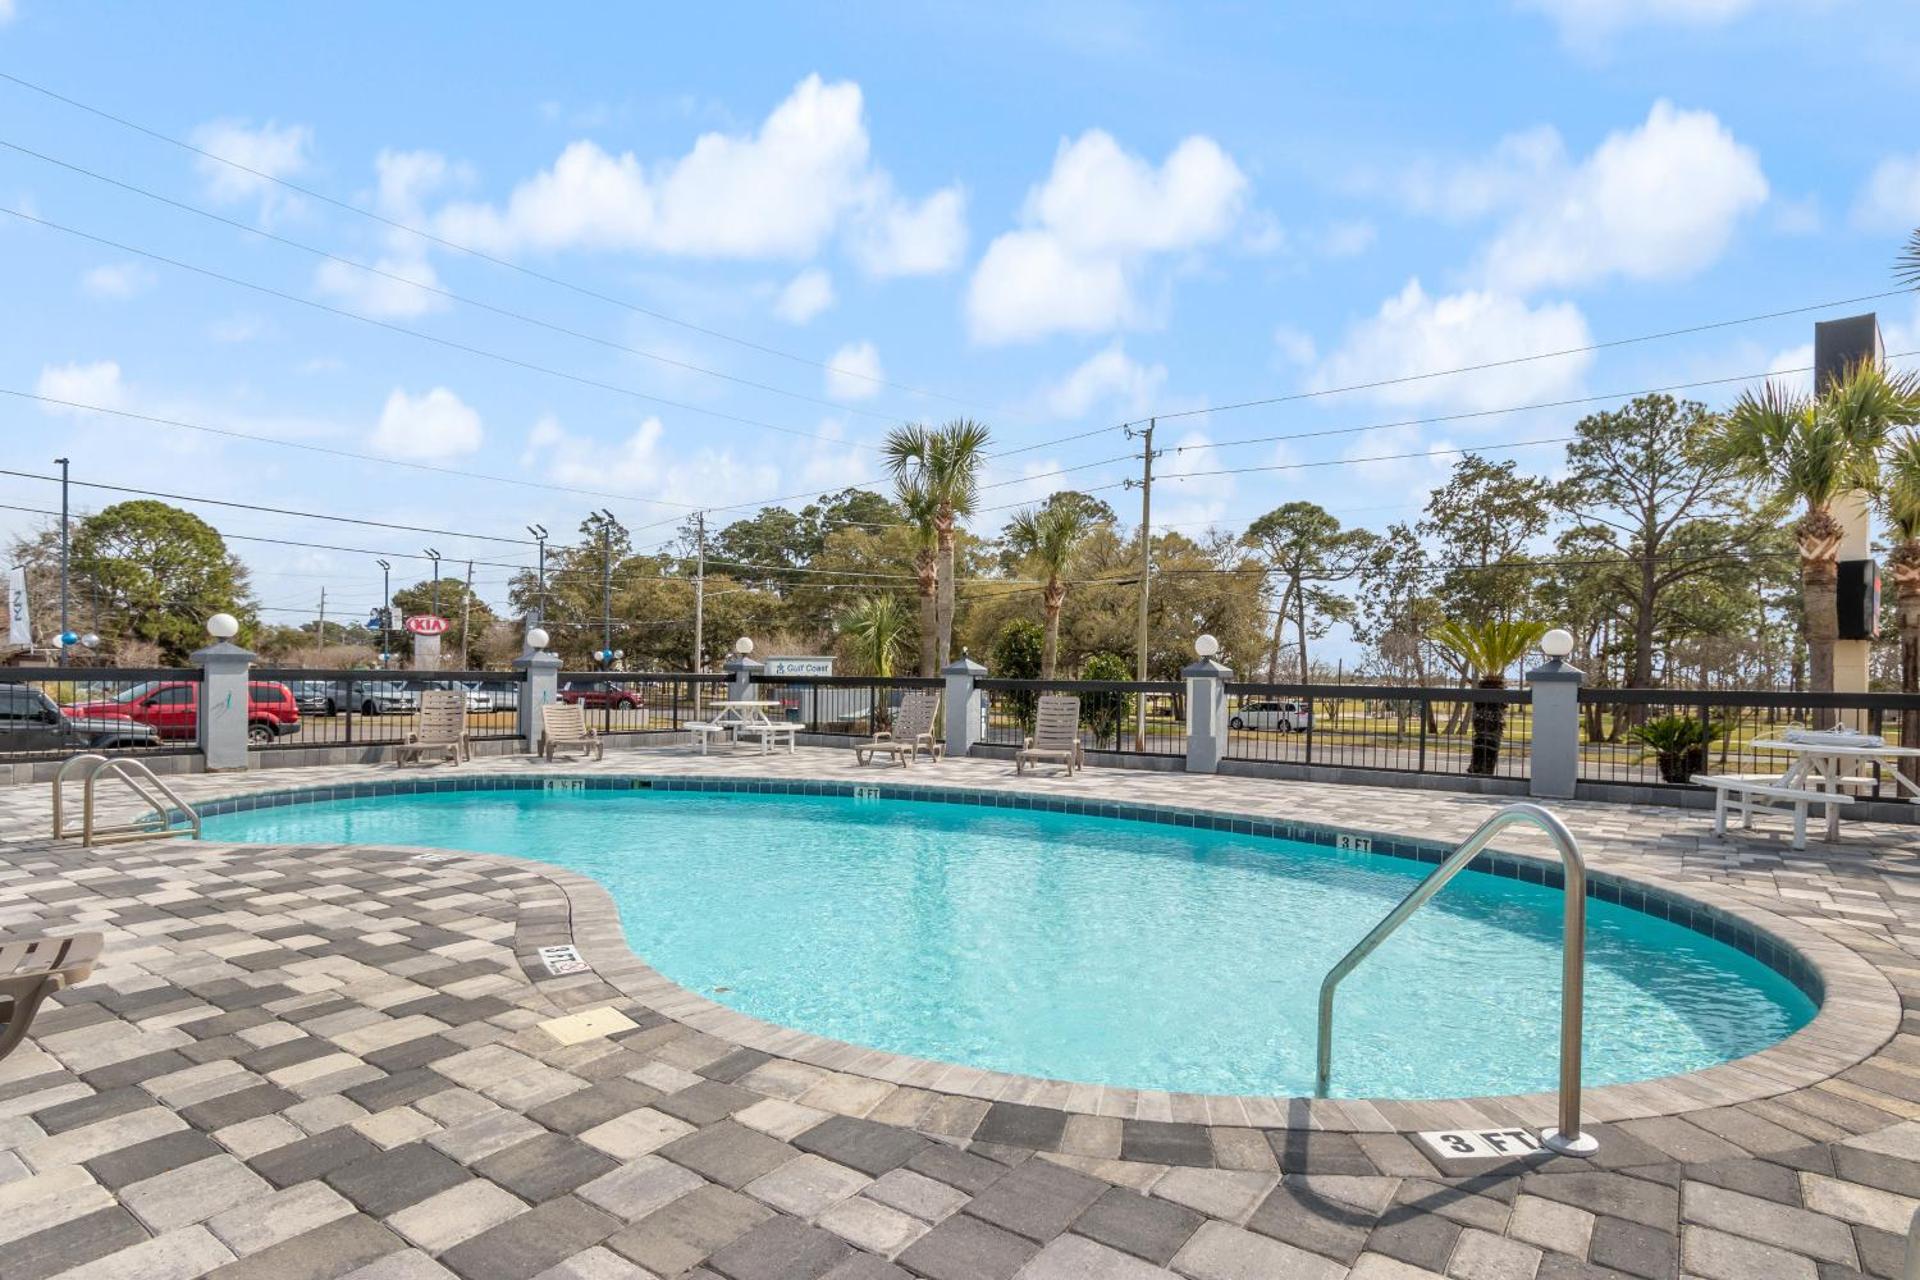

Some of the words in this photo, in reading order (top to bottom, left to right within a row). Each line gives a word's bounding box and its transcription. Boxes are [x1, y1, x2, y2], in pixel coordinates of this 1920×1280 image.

[414, 619, 442, 631] KIA
[787, 664, 804, 673] Gulf
[806, 664, 828, 673] Coast
[571, 781, 583, 790] FT
[867, 789, 879, 799] FT
[1342, 836, 1350, 849] 3
[1354, 838, 1370, 851] FT
[1440, 1134, 1475, 1153] 3
[1479, 1131, 1538, 1152] FT
